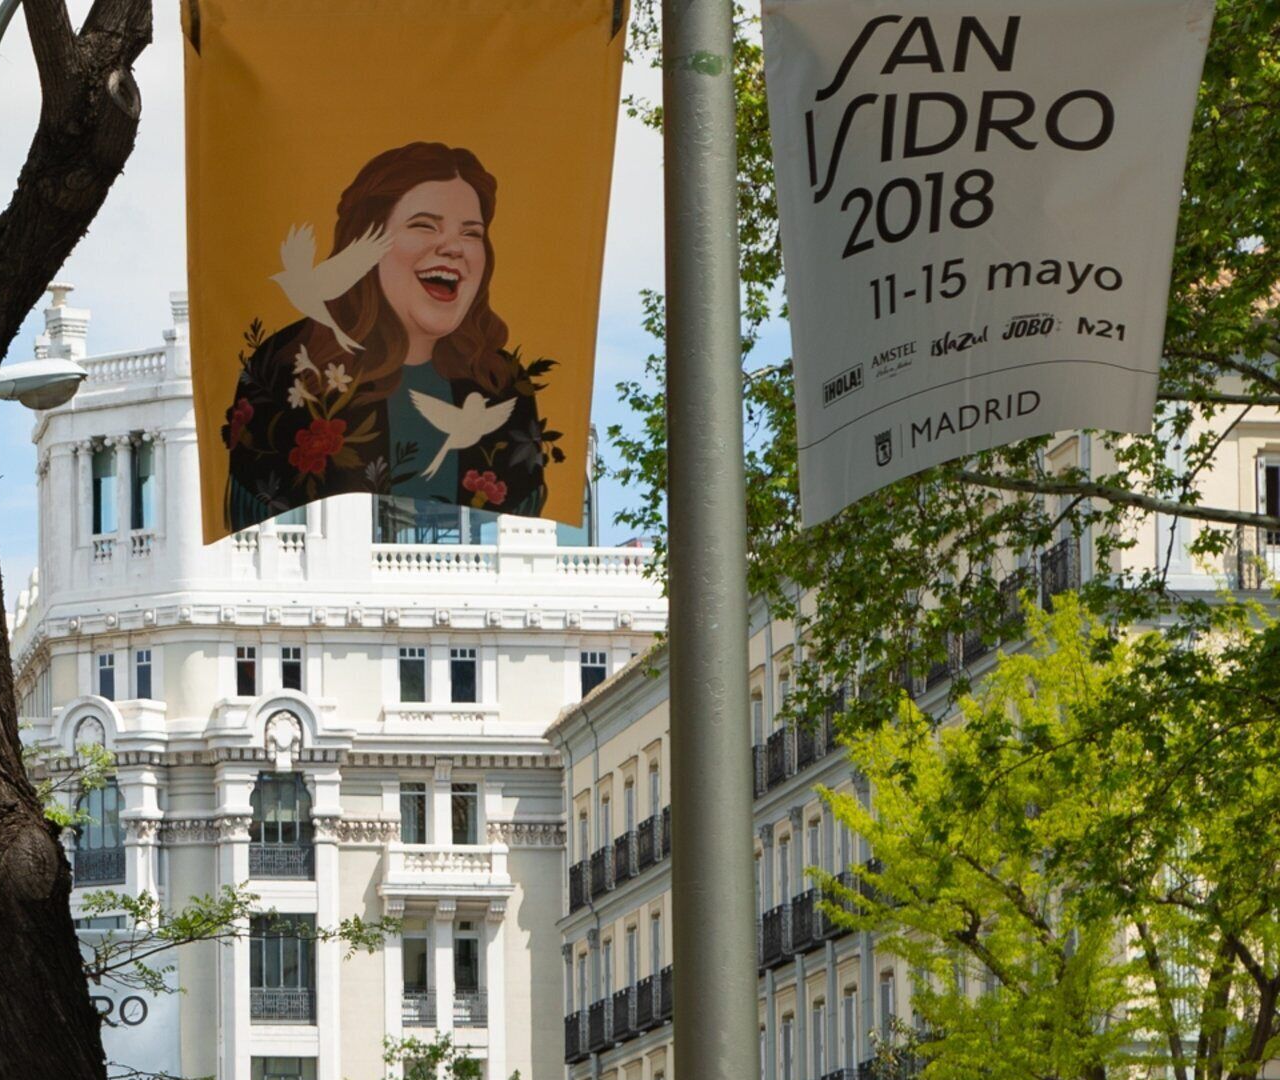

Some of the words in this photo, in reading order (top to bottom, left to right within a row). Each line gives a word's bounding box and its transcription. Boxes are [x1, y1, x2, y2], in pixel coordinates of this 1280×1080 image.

[815, 14, 1021, 102] SAN
[805, 89, 1115, 203] ISIDRO
[840, 168, 995, 260] 2018
[869, 257, 968, 320] 11-15
[986, 258, 1123, 294] mayo
[871, 341, 917, 369] AMSTEL
[1002, 317, 1054, 341] JOBO
[911, 390, 1041, 450] MADRID
